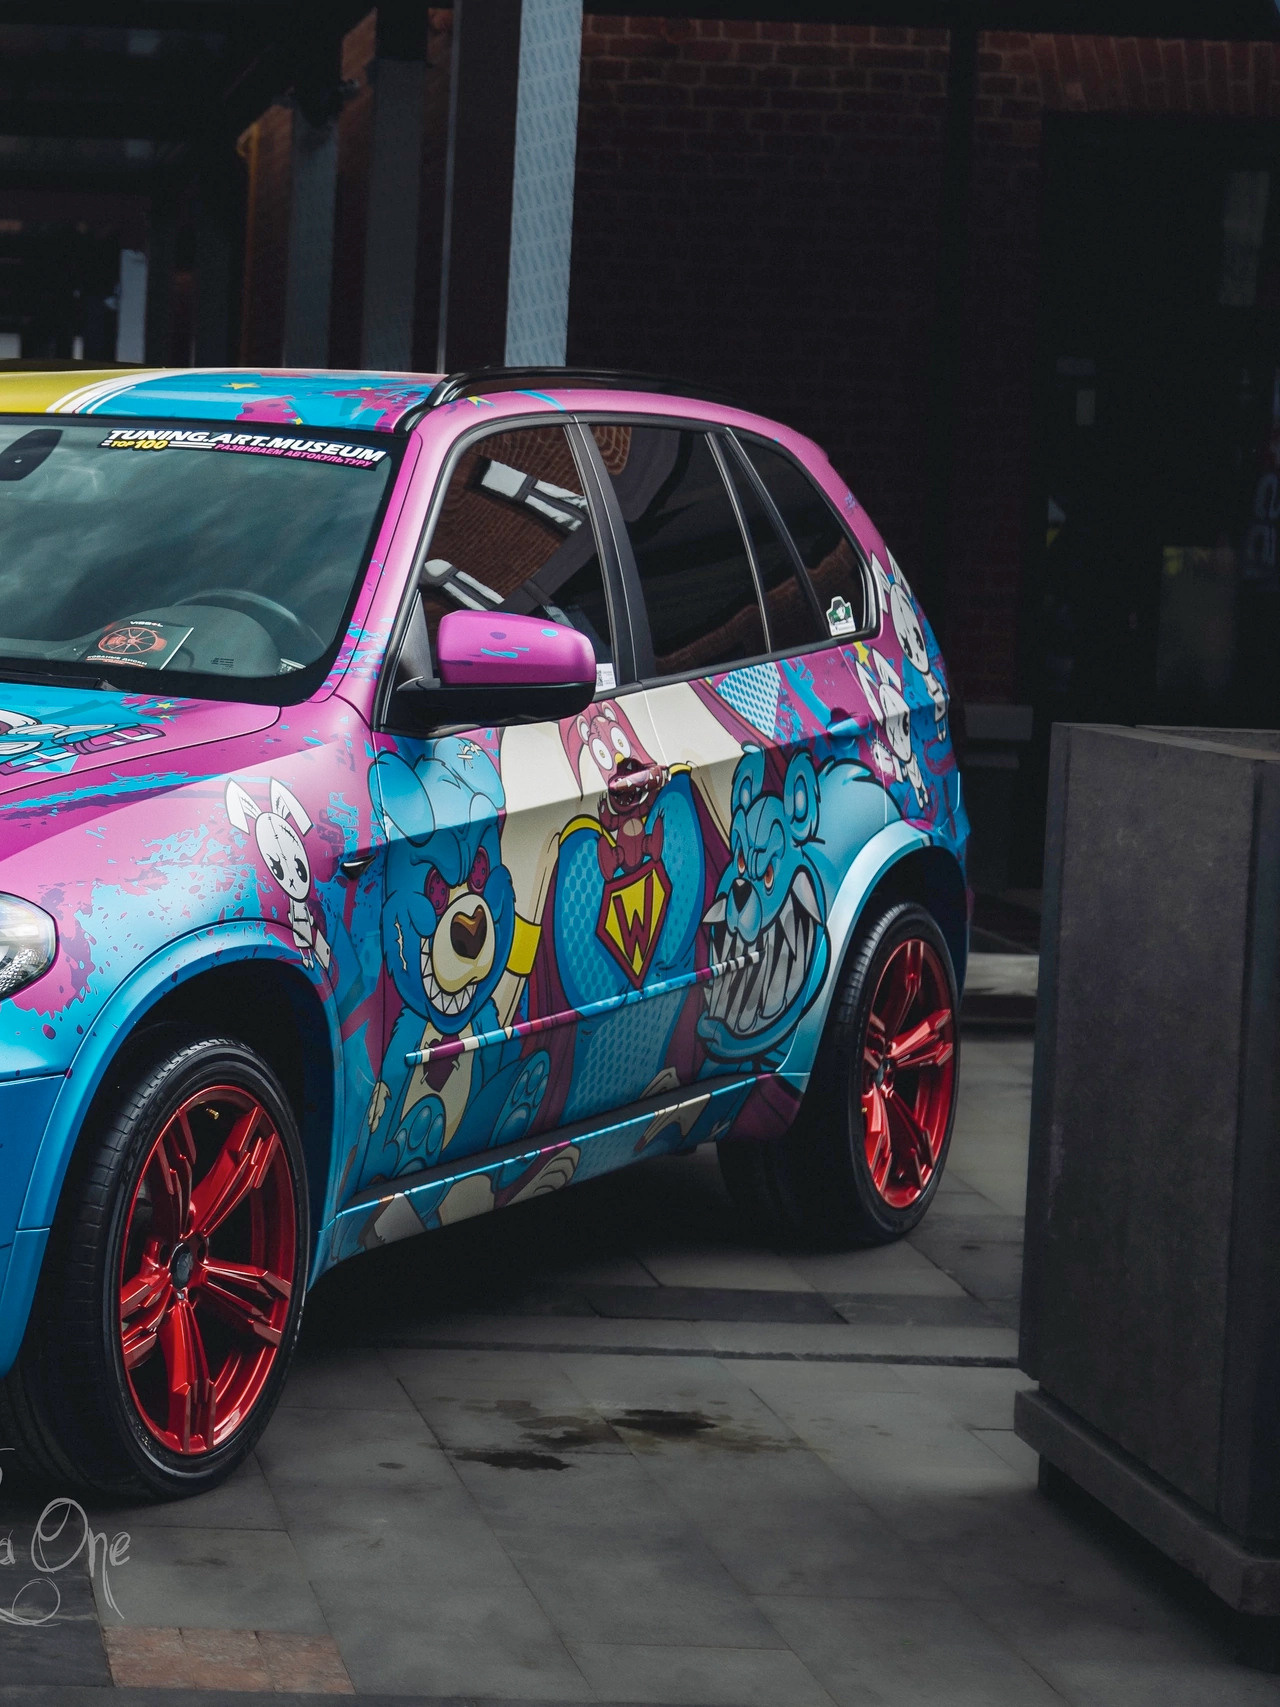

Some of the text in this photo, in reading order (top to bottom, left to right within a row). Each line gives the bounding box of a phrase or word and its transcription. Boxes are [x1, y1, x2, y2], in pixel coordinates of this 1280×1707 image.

[108, 430, 387, 462] TUNING.ART.MUSEUM
[215, 443, 373, 467] РАЗВИВАЕМ АВТОКУЛЬТУРУ
